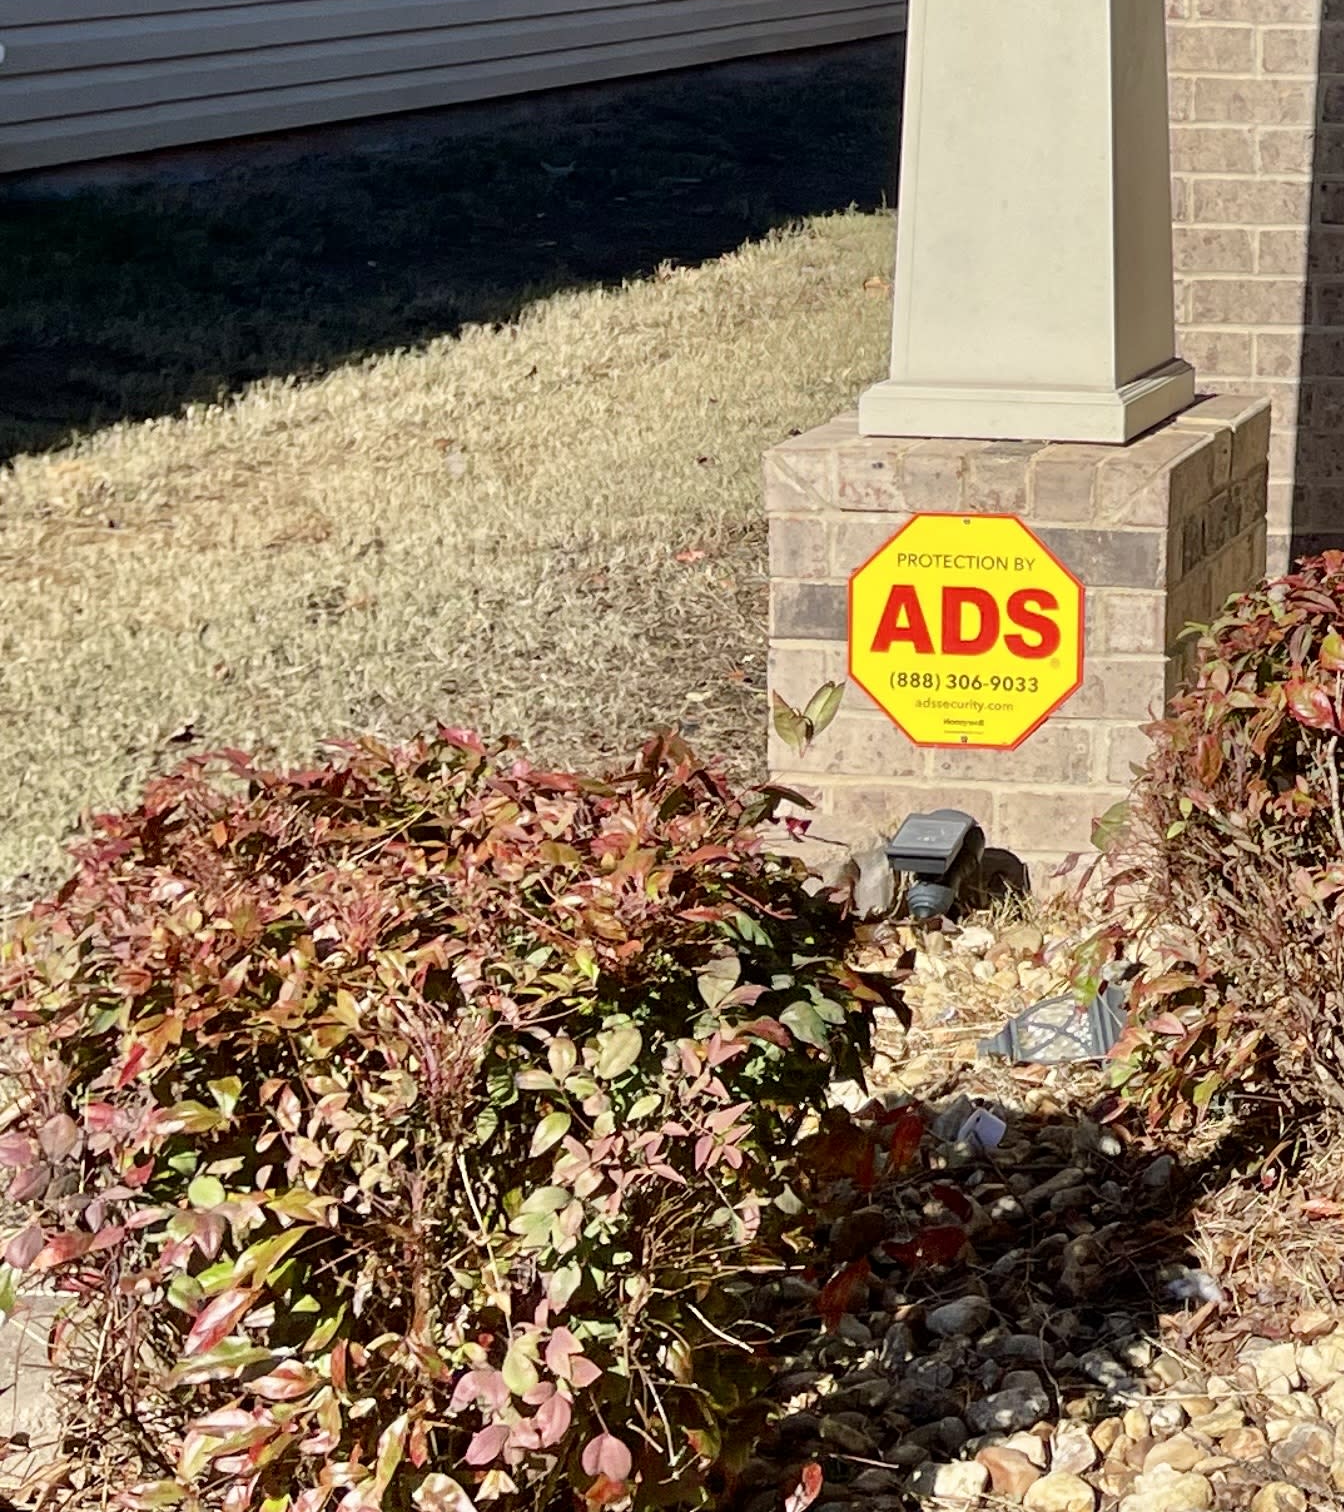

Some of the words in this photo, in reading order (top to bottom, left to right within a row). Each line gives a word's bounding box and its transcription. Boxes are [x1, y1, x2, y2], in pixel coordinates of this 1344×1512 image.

[896, 552, 1009, 570] PROTECTION
[1013, 555, 1036, 571] BY
[869, 584, 1062, 660] ADS
[889, 672, 941, 692] (888)
[946, 673, 1040, 693] 306-9033
[914, 696, 1014, 713] adssecurity.com
